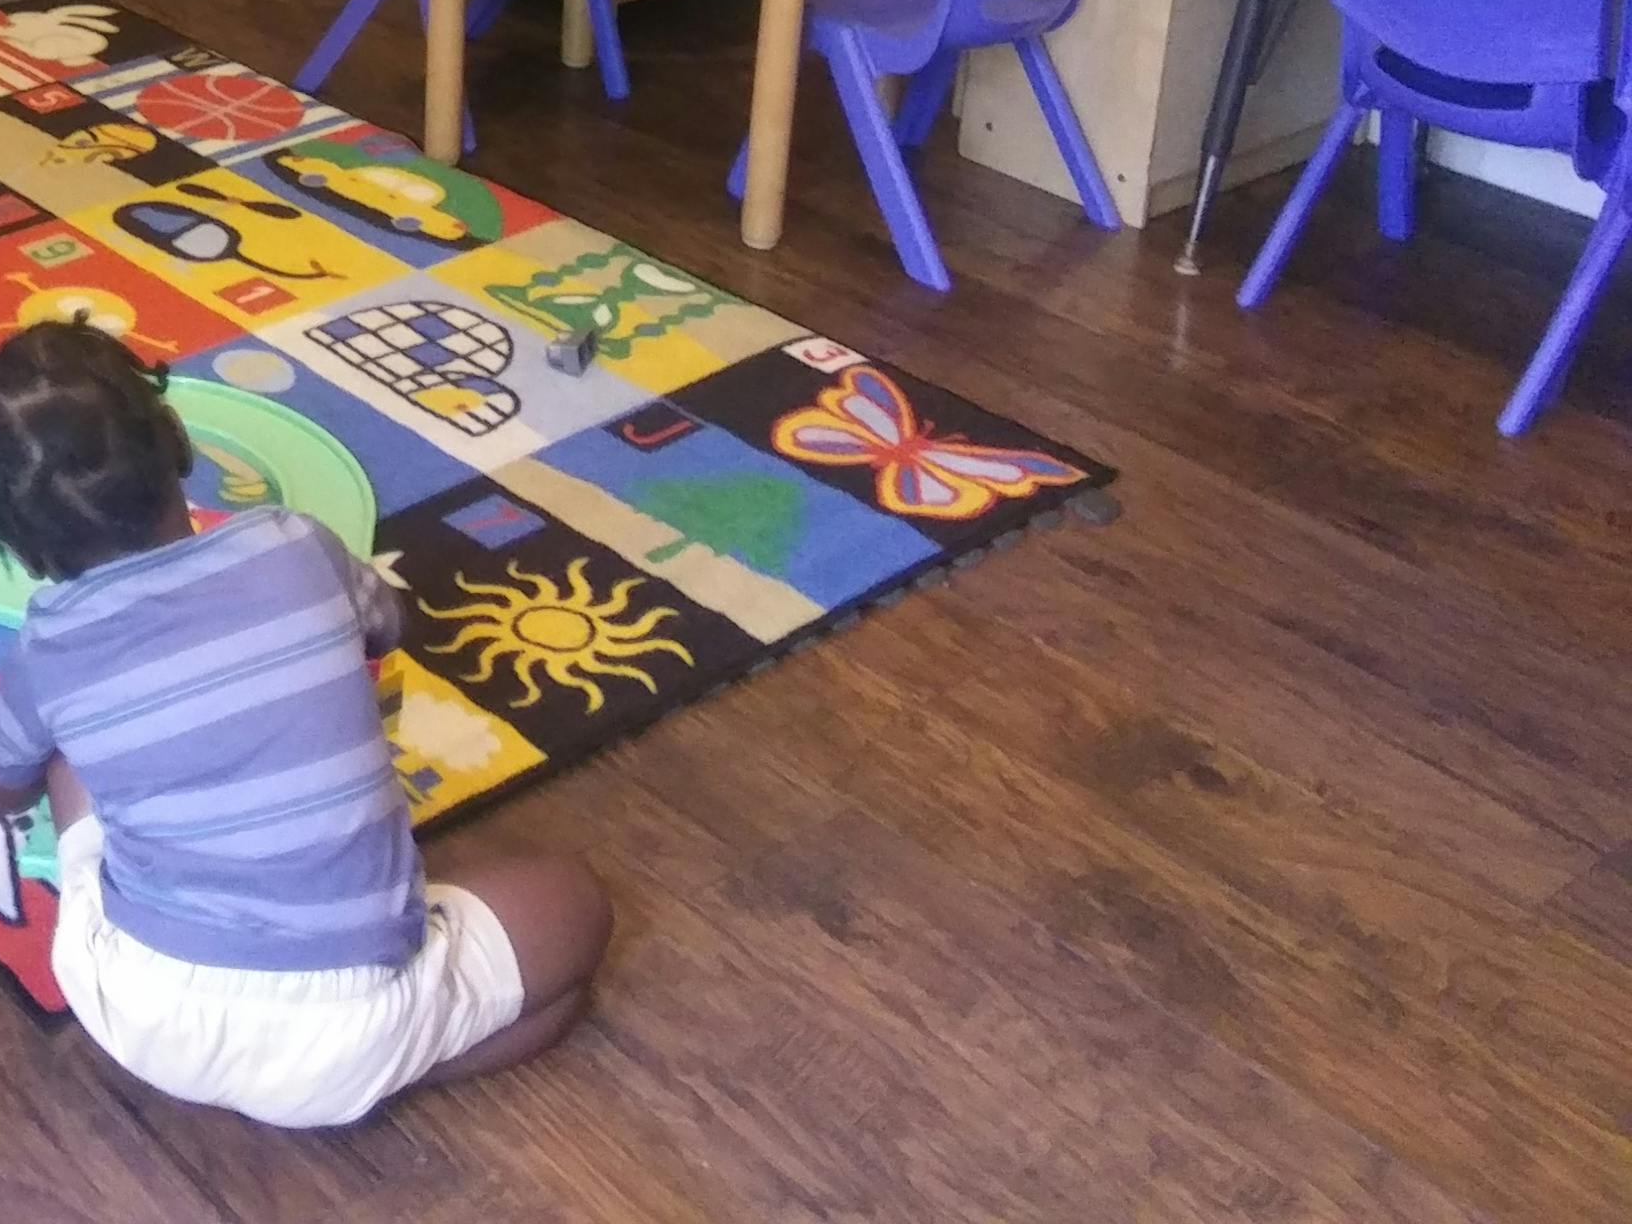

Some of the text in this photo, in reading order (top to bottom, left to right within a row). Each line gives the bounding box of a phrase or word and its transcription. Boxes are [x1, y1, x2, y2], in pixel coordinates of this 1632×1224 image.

[30, 91, 68, 111] 5
[31, 240, 76, 259] 9
[235, 286, 274, 302] 1
[803, 348, 845, 366] 3
